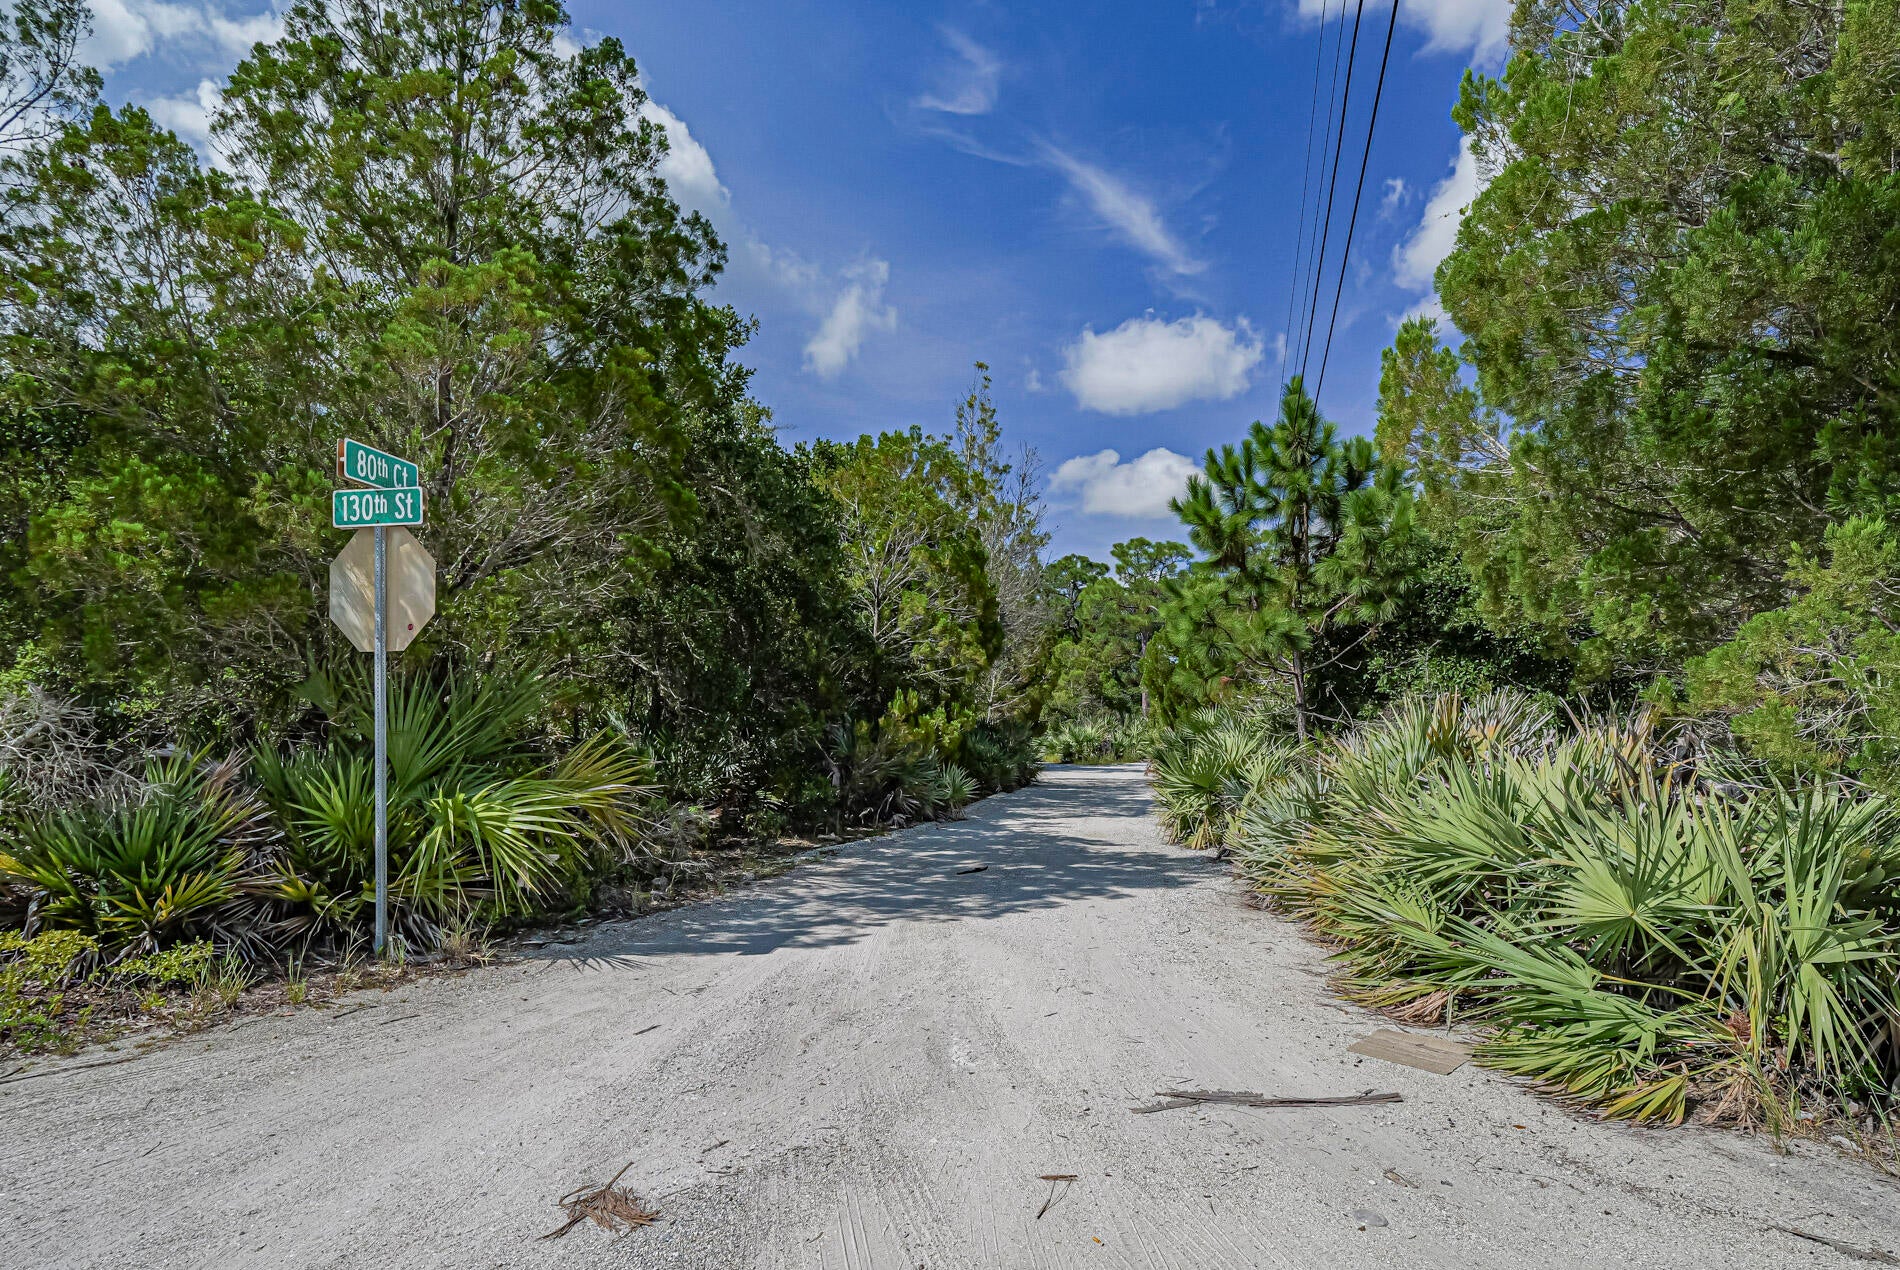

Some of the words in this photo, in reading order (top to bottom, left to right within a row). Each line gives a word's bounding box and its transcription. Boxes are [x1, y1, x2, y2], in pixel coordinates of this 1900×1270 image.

[357, 450, 388, 480] 80th
[394, 464, 408, 488] Ct
[342, 494, 388, 521] 130th
[395, 492, 413, 519] St
